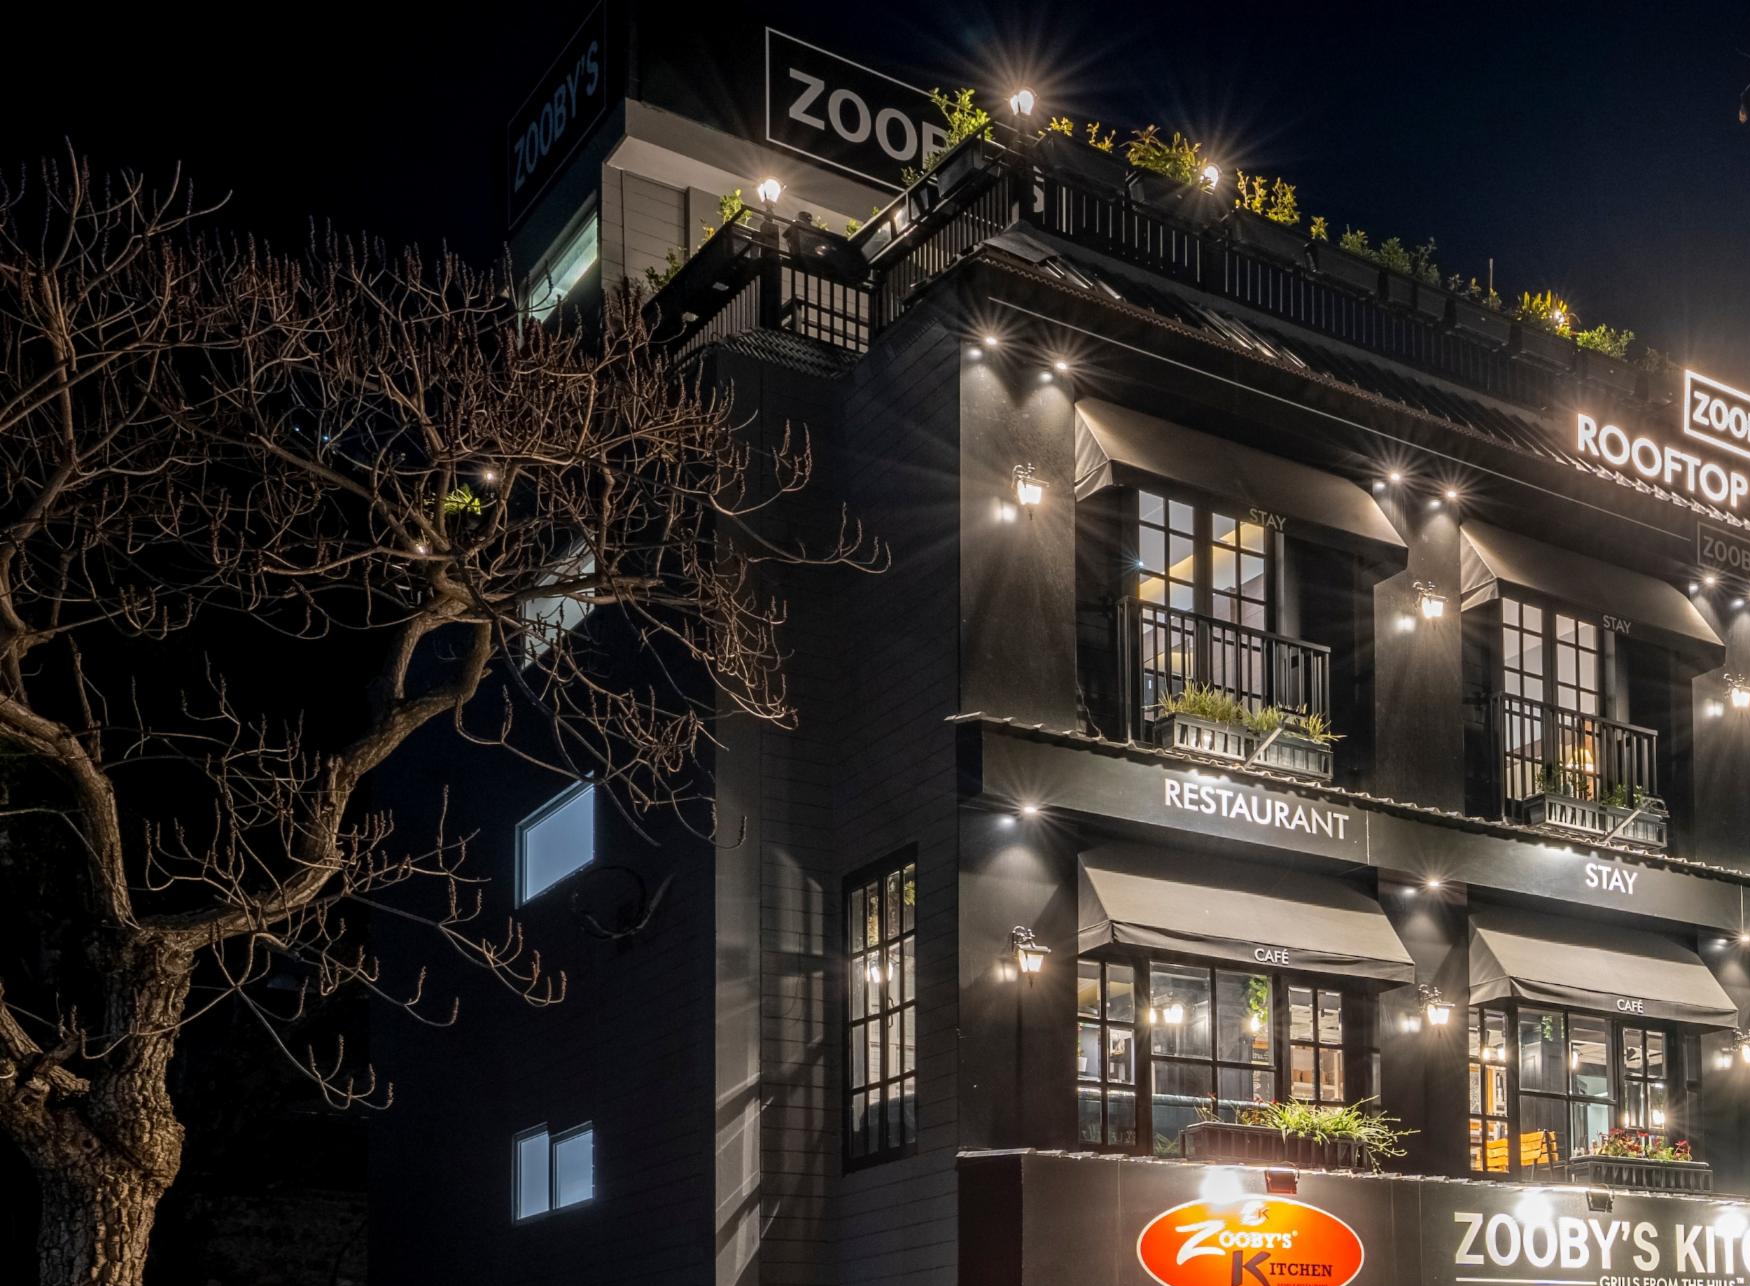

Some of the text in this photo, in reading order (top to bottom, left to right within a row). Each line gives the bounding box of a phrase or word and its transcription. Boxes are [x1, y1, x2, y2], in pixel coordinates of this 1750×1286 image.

[514, 40, 599, 192] ZOOBY'S
[1577, 412, 1749, 508] ROOFTOP
[1249, 508, 1288, 532] STAY
[1603, 614, 1632, 634] STAY
[1164, 778, 1349, 840] RESTAURANT
[1585, 862, 1639, 896] STAY
[1254, 947, 1289, 965] CAFÉ
[1616, 998, 1644, 1014] CAFÉ
[1454, 1211, 1660, 1272] ZOOBY'S
